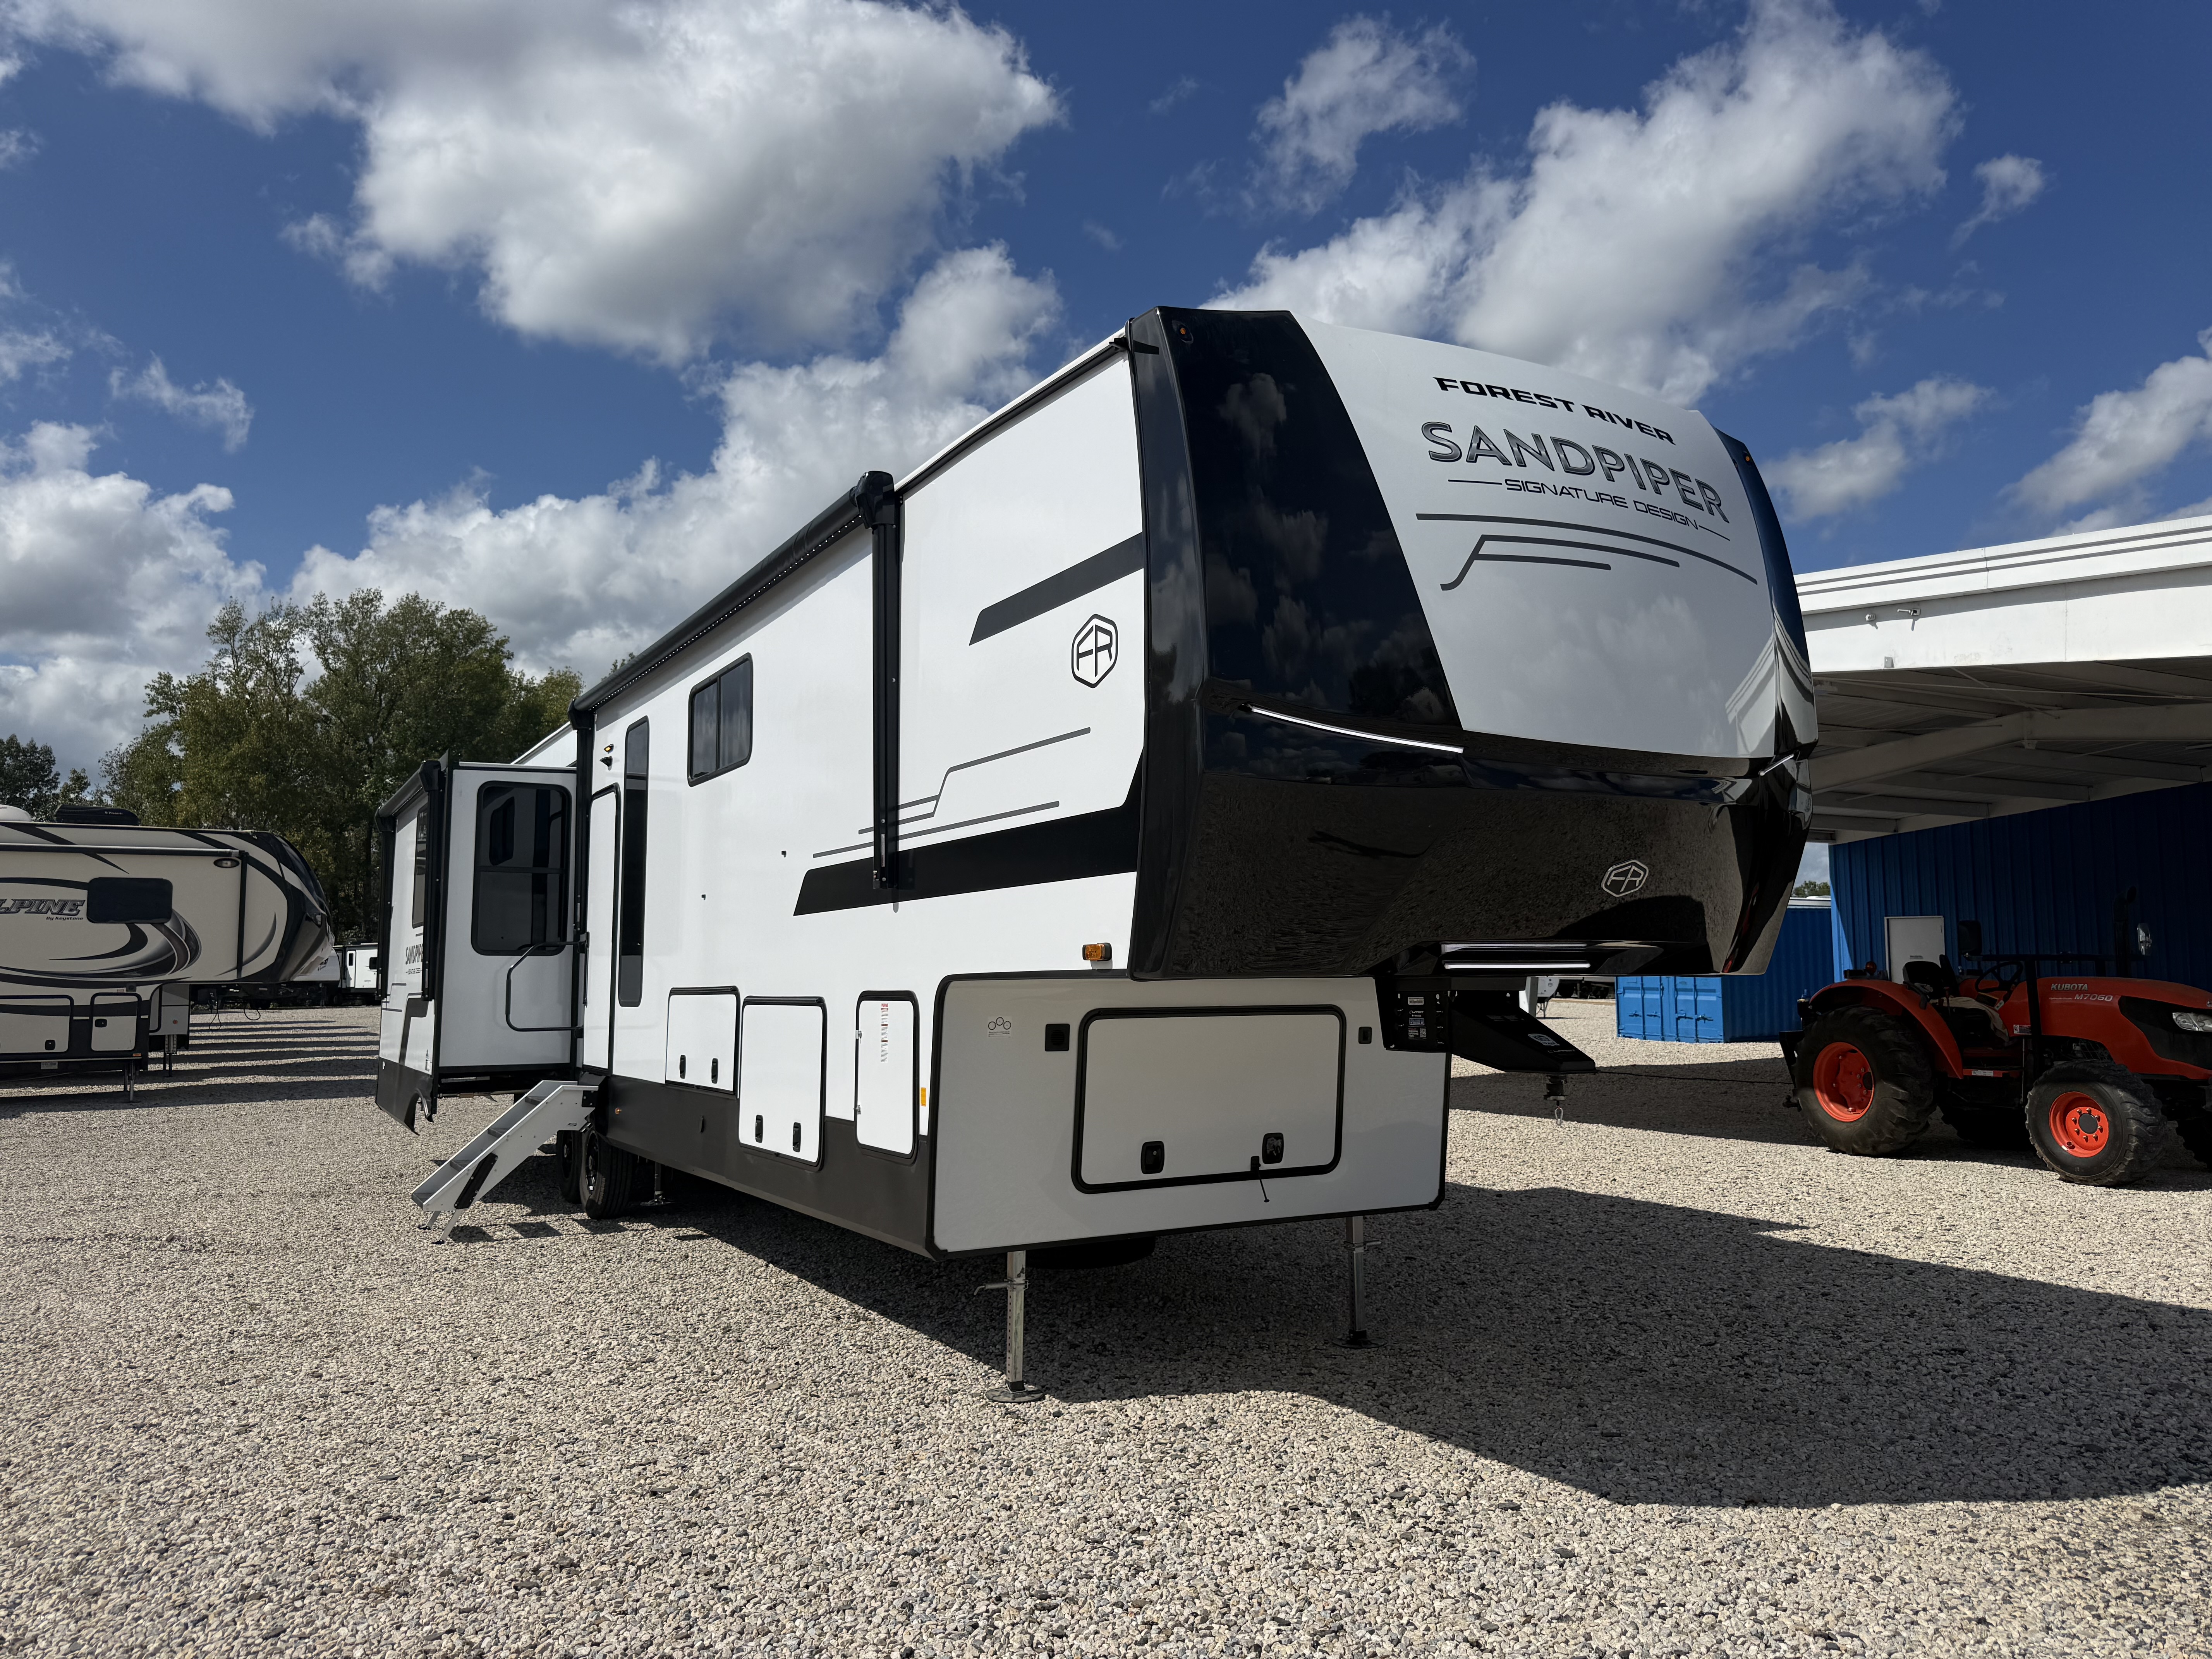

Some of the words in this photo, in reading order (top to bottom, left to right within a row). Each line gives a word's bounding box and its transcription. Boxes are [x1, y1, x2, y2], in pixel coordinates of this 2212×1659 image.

[1432, 377, 1575, 412] FOREST
[1580, 404, 1676, 446] RIVER
[1421, 421, 1729, 524] SANDPIPER
[1504, 479, 1628, 508] SIGNATURE
[1633, 500, 1698, 530] DESIGN
[0, 898, 86, 916] LPINE
[405, 943, 423, 965] SANDPIPE
